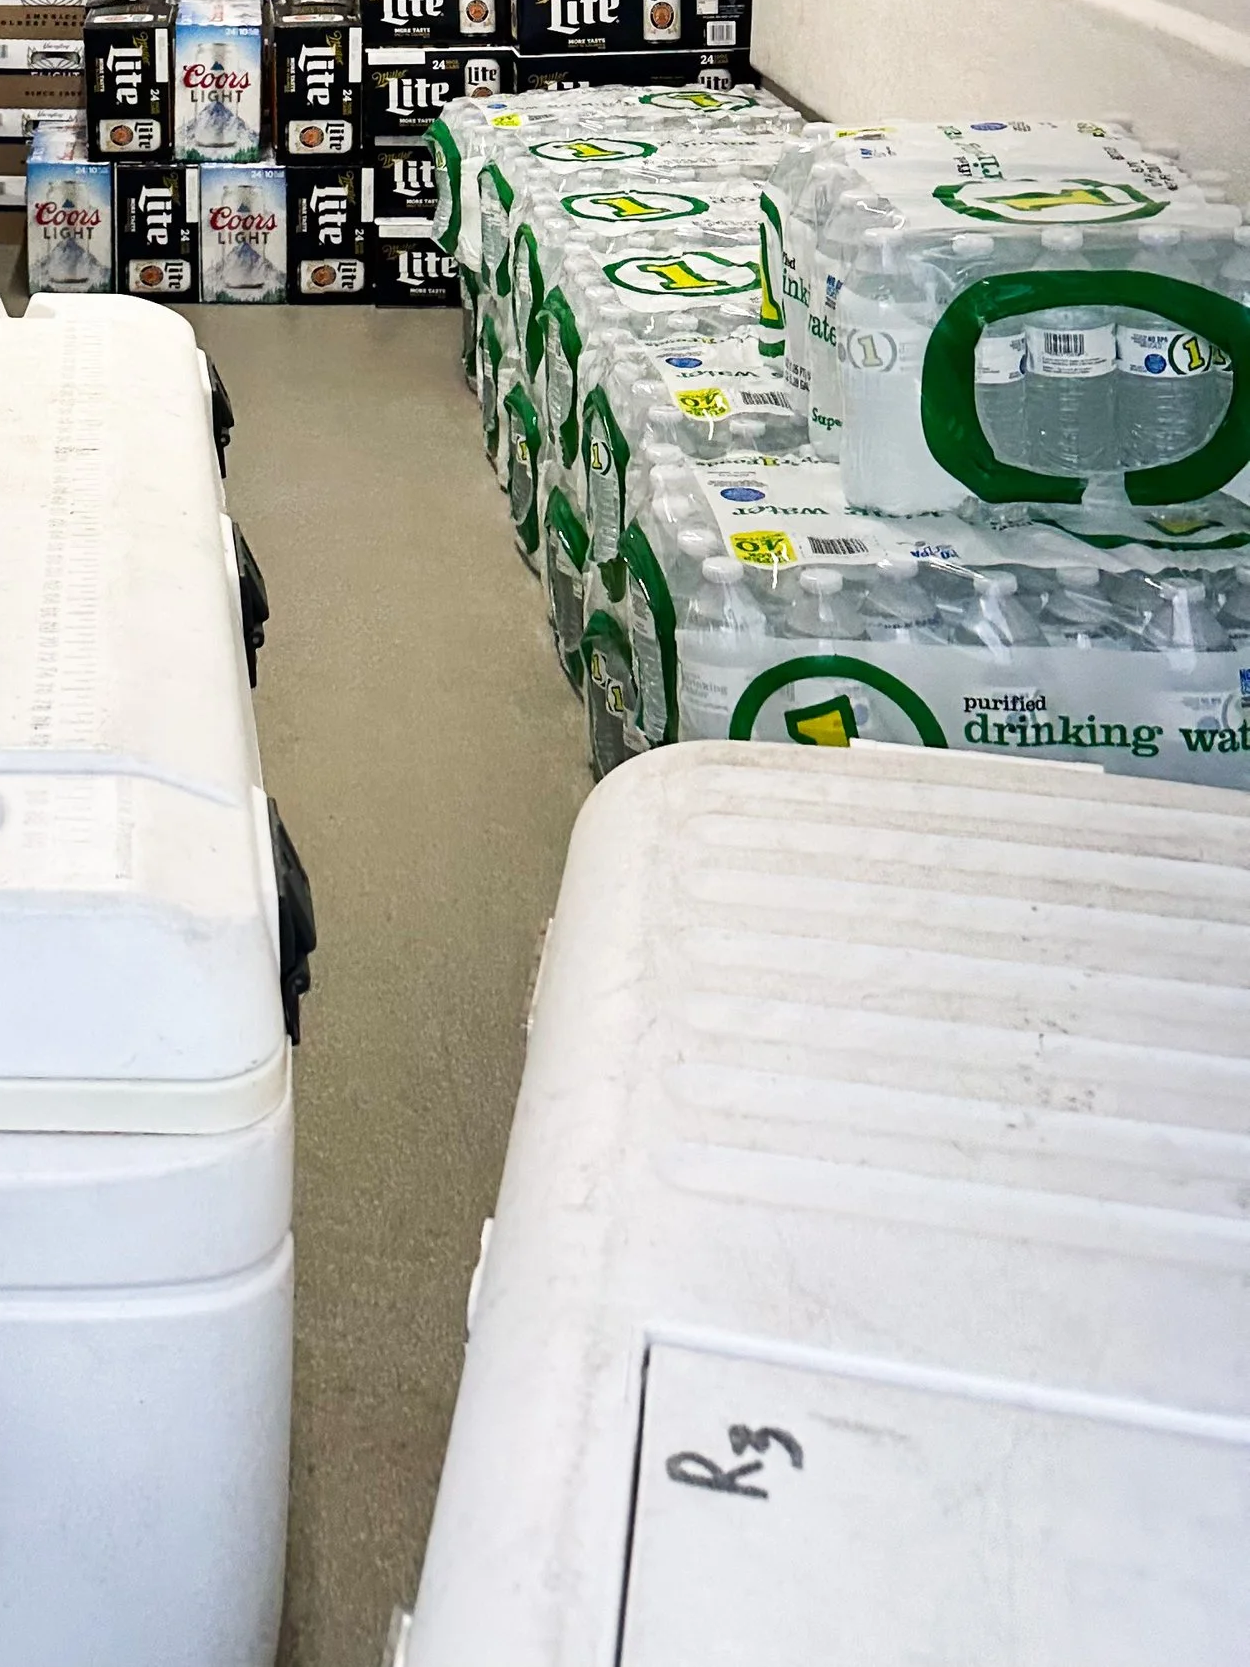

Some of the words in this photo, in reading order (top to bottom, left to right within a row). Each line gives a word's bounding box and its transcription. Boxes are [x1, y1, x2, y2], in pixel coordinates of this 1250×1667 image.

[432, 60, 445, 69] 24
[700, 55, 714, 64] 24
[106, 44, 143, 106] Lite
[183, 64, 251, 89] Coors
[298, 44, 336, 106] Lite
[468, 66, 497, 85] Lite
[150, 89, 160, 102] 24
[190, 90, 243, 103] LIGHT
[342, 89, 352, 102] 24
[386, 78, 449, 116] Lite
[135, 122, 153, 150] Lite
[326, 122, 345, 151] Lite
[393, 159, 435, 196] Lit
[34, 201, 102, 227] Coors
[138, 185, 172, 246] Lite
[209, 206, 277, 232] Coors
[310, 185, 347, 246] Lite
[43, 227, 95, 240] LIGHT
[181, 229, 190, 241] 24
[218, 231, 269, 245] LIGHT
[354, 228, 364, 241] 24
[164, 262, 183, 289] Lite
[337, 261, 357, 289] Lite
[397, 251, 459, 285] Lite
[731, 506, 830, 517] water
[963, 695, 1047, 713] purified
[964, 713, 1163, 757] drinking
[666, 1424, 803, 1499] R3
